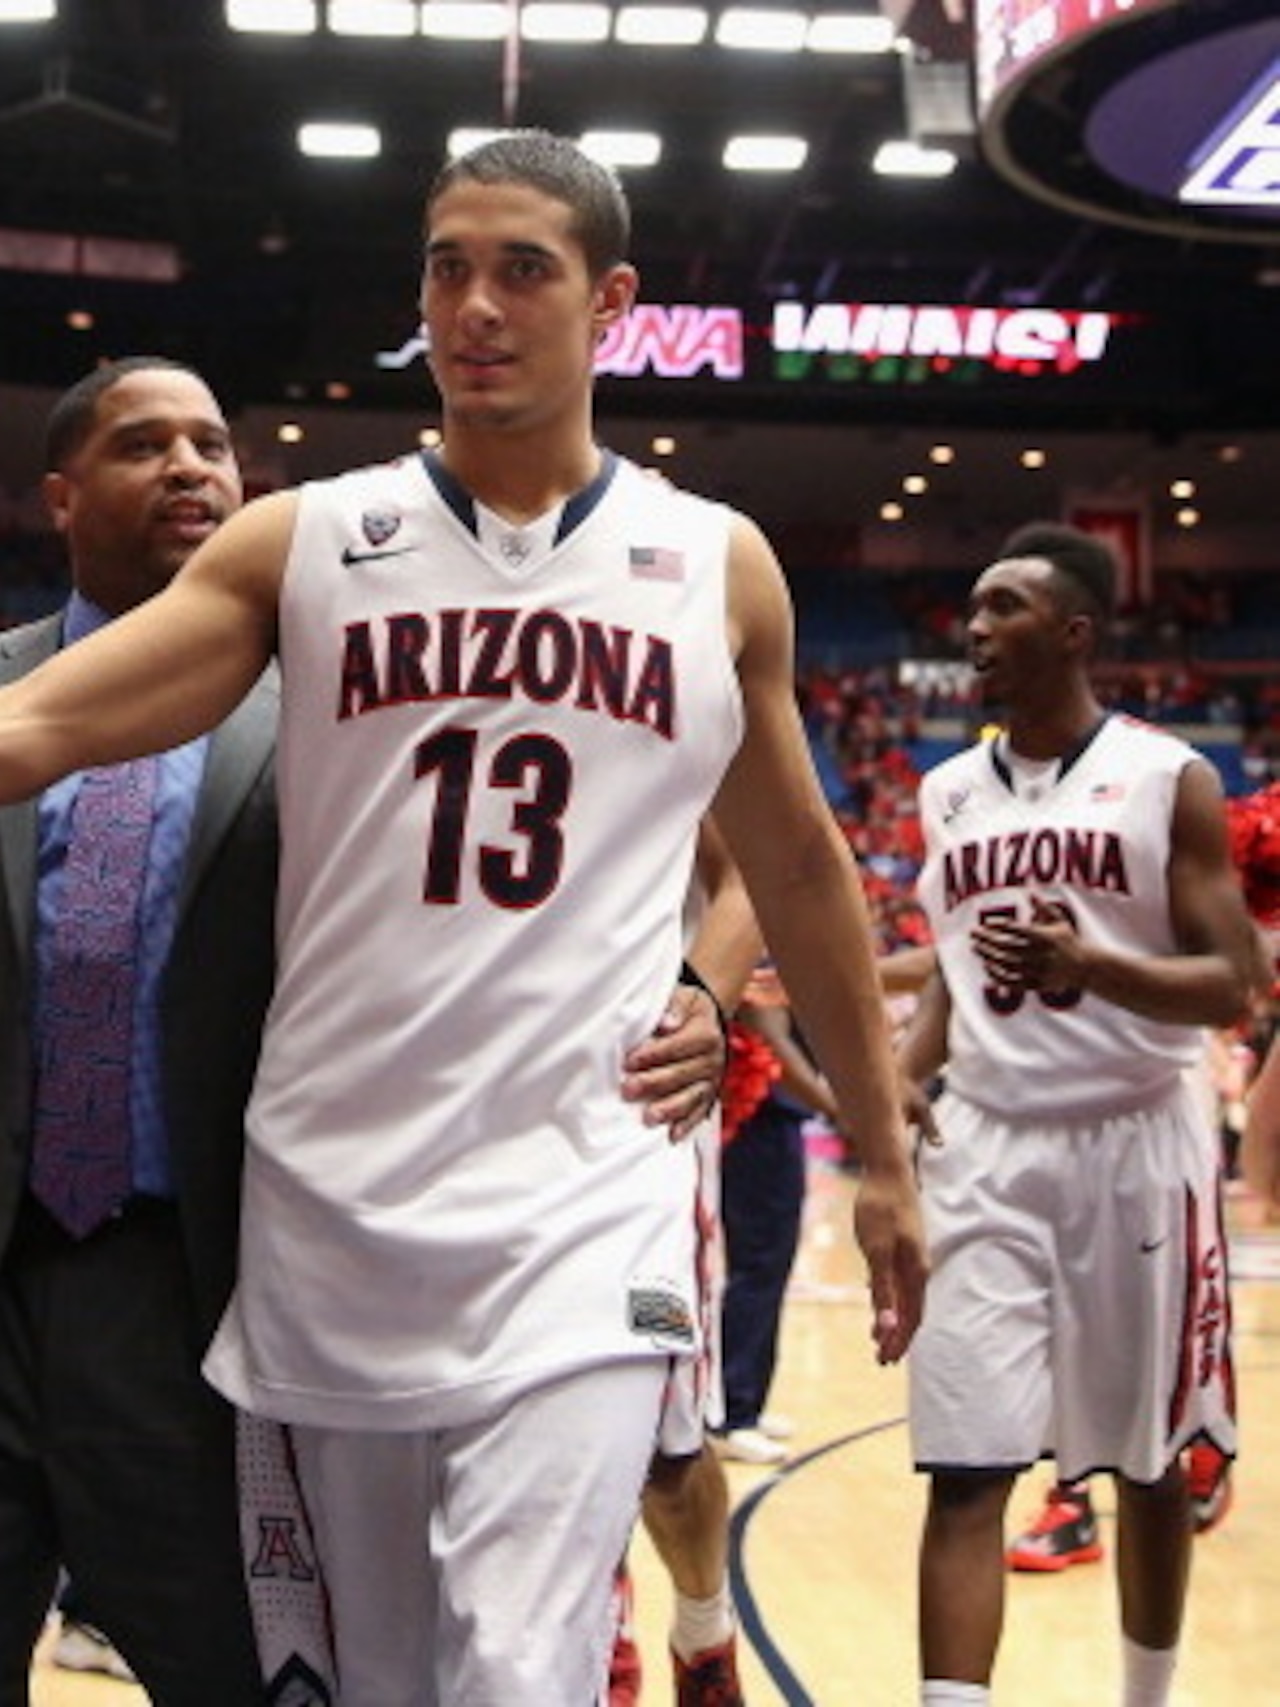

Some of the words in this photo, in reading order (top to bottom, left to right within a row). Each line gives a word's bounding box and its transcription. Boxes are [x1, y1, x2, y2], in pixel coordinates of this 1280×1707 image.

[337, 608, 676, 742] ARIZONA
[414, 725, 573, 910] 13
[941, 827, 1132, 915] ARIZONA
[251, 1516, 314, 1582] A
